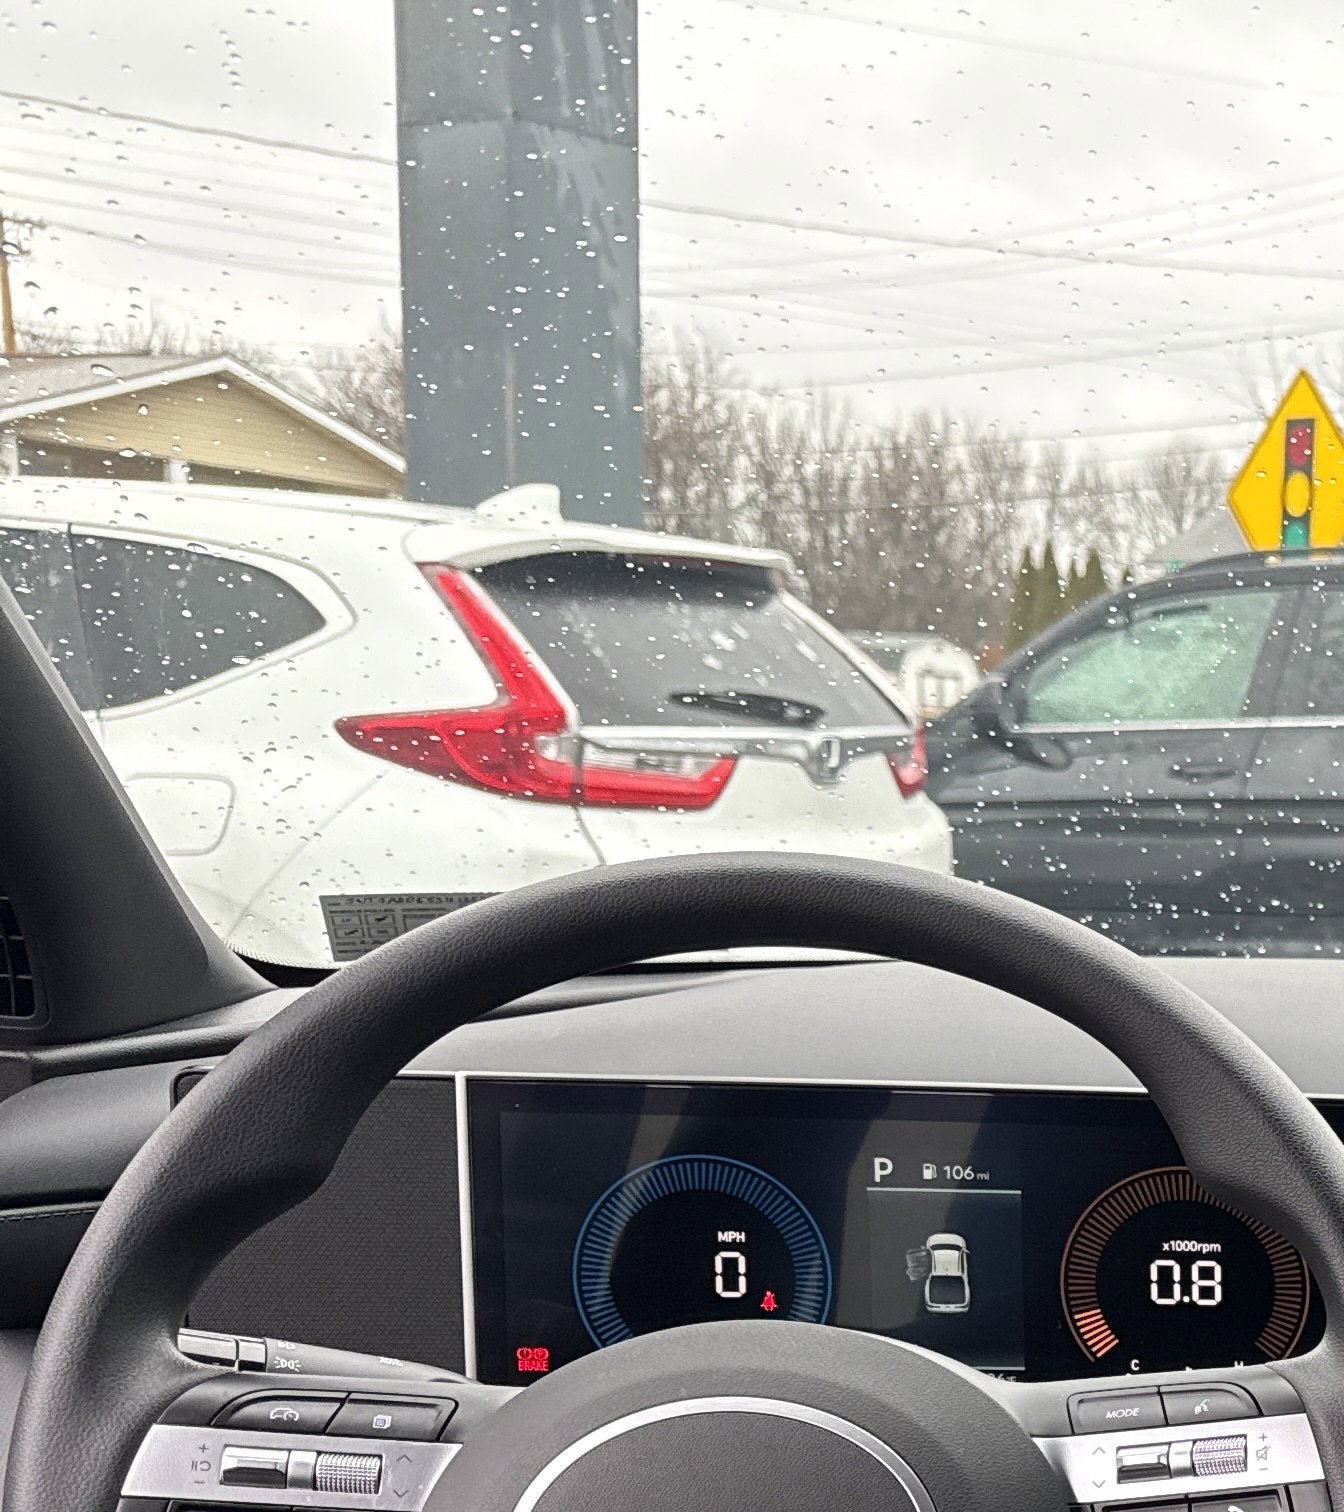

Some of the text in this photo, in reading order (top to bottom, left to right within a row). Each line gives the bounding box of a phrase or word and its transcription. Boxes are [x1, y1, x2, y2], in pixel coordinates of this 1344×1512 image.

[874, 1158, 894, 1182] P
[943, 1165, 990, 1180] 106 mi
[717, 1230, 746, 1242] MPH
[1162, 1240, 1222, 1254] x1000rpm
[714, 1251, 746, 1298] 0
[1150, 1259, 1222, 1306] 0.8
[518, 1360, 549, 1372] BRAKE
[1130, 1359, 1140, 1372] C
[1106, 1407, 1140, 1420] MODE
